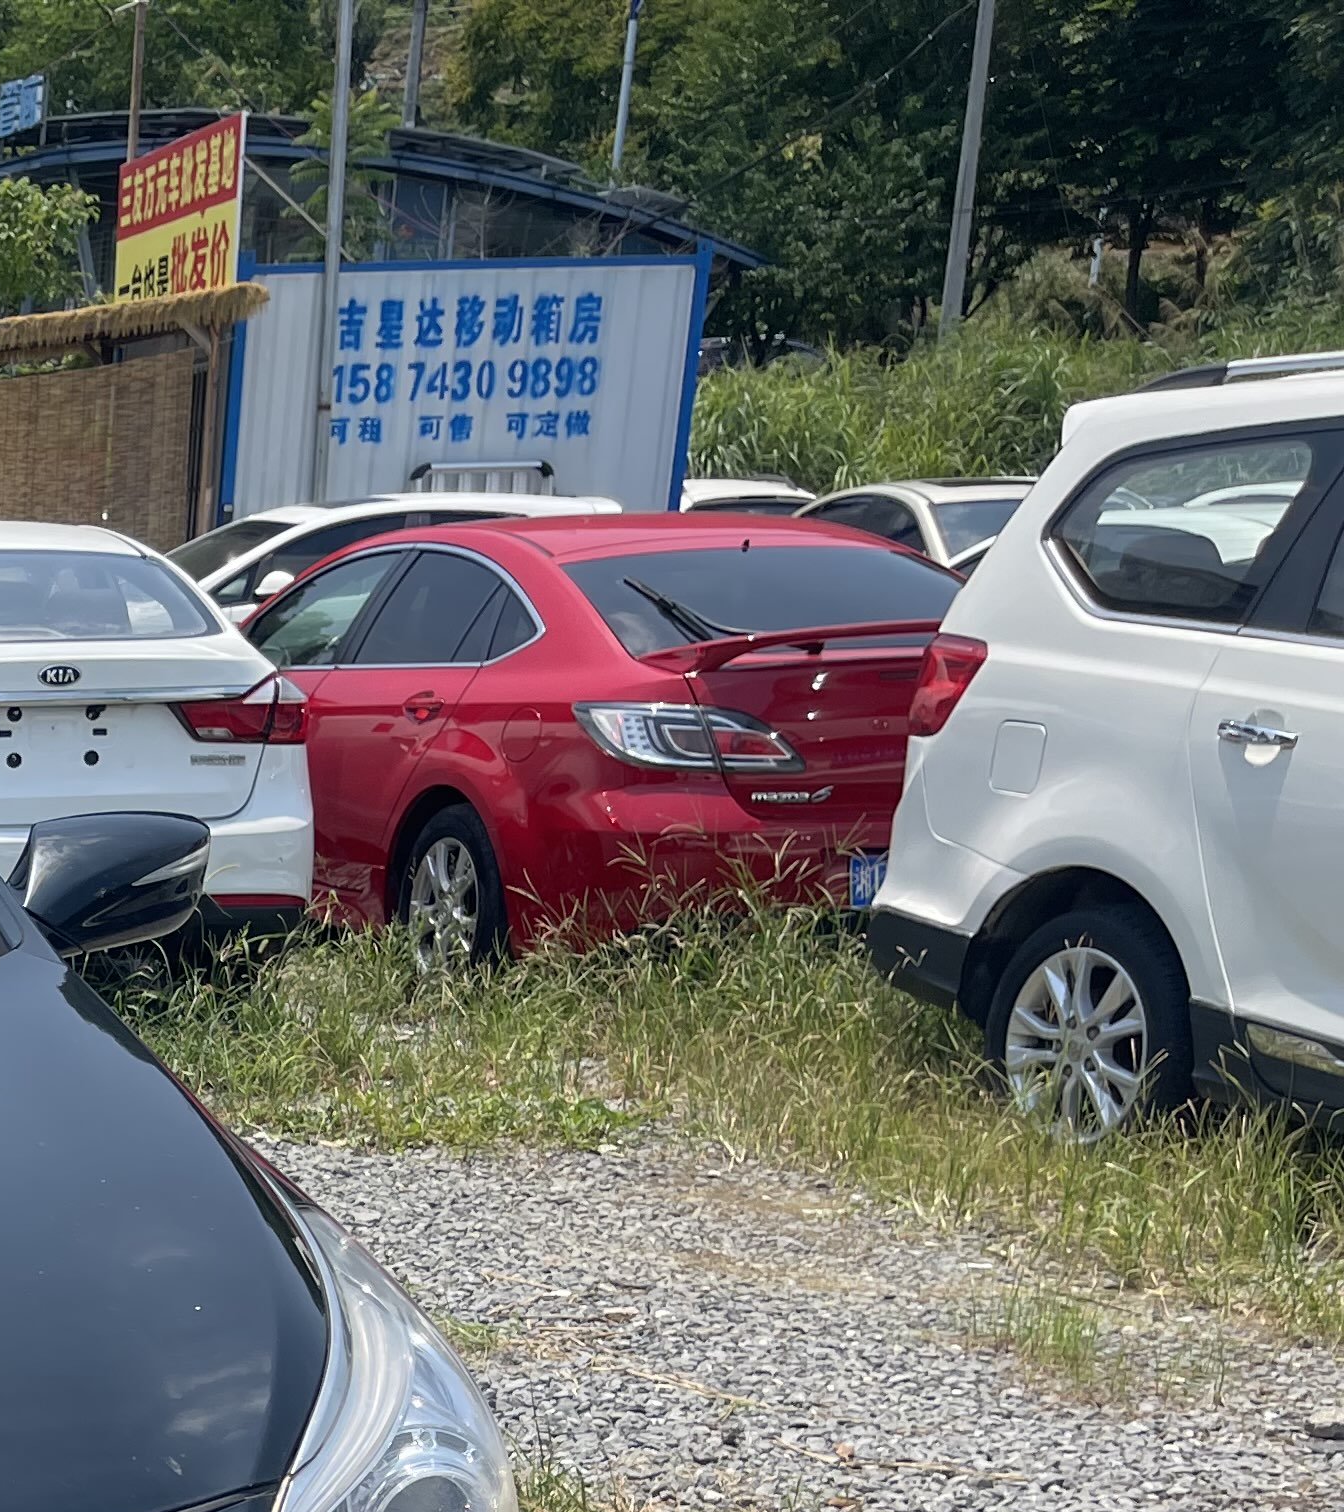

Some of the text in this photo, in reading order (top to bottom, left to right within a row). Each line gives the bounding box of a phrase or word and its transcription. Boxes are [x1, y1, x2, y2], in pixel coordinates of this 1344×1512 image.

[338, 292, 603, 351] 吉星达移动箱房
[332, 356, 598, 403] 158 7430 9898
[330, 409, 591, 444] 可租 可售 可定做
[46, 669, 75, 683] KIA
